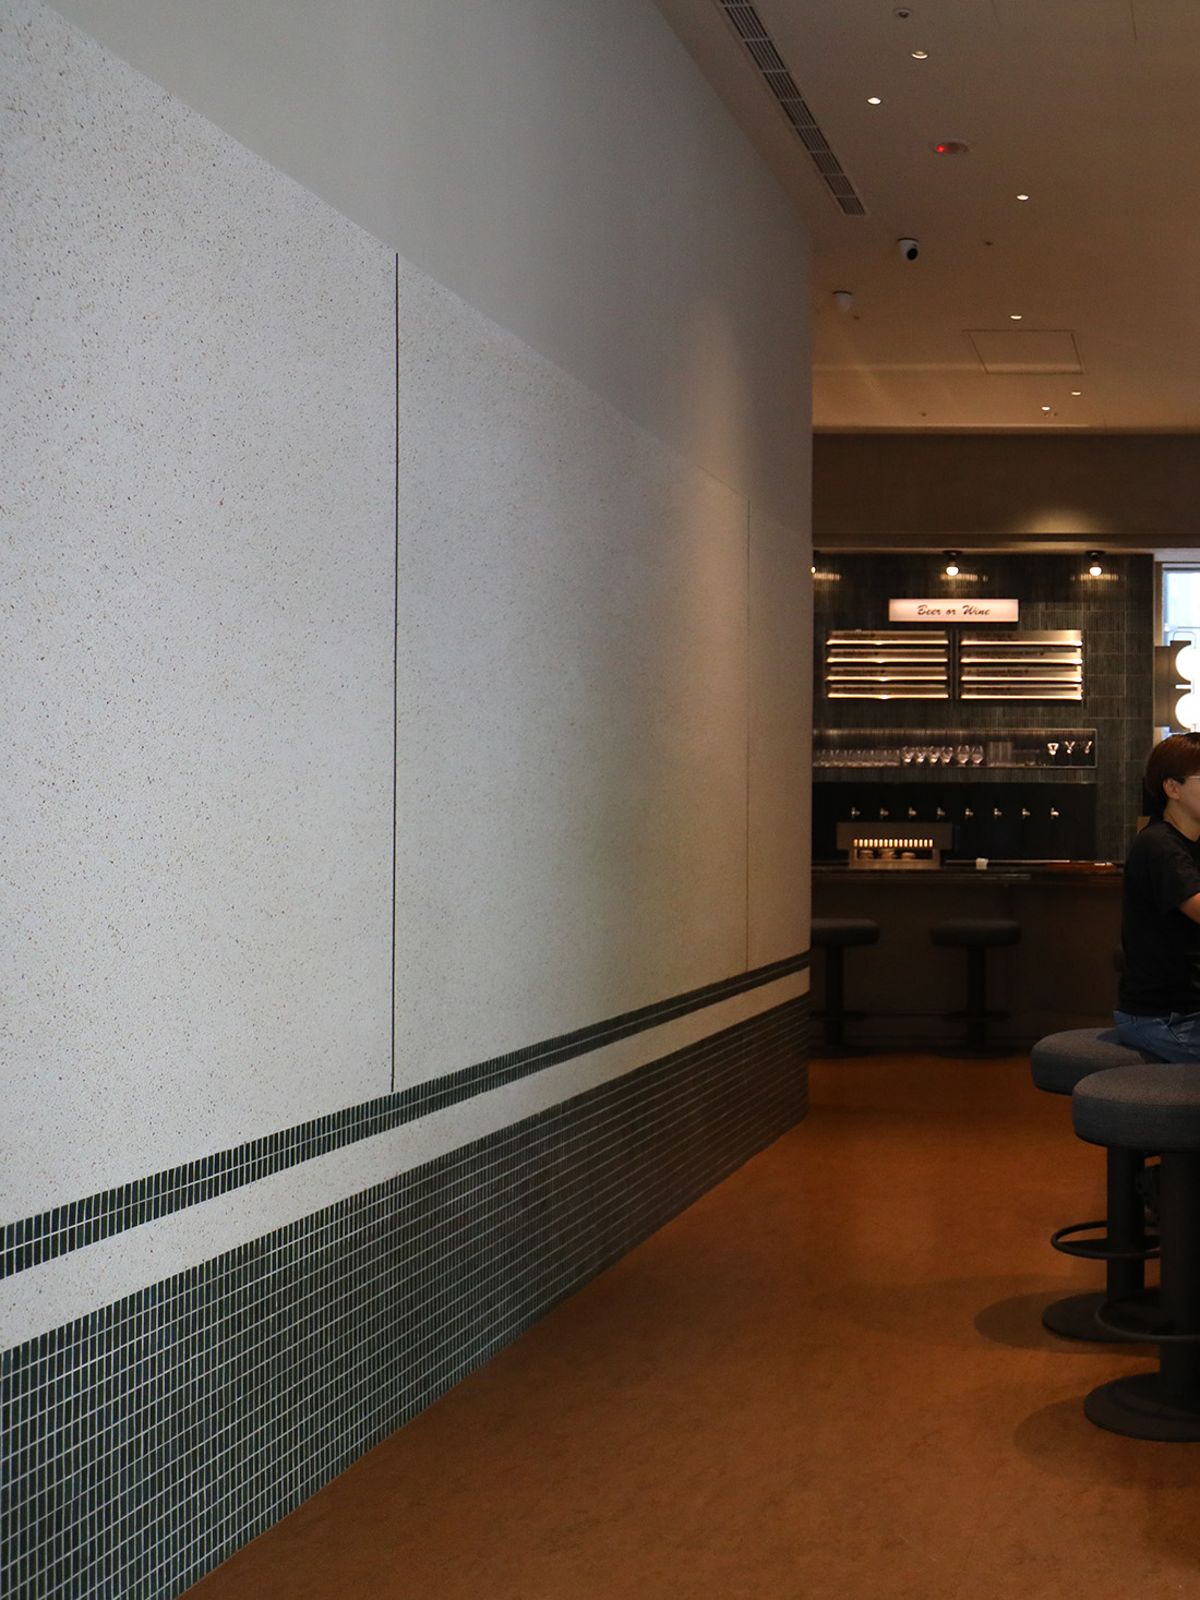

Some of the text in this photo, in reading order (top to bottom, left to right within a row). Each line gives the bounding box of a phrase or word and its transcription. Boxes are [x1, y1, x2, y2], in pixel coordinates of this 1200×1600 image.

[917, 604, 991, 616] Beer or Wine
